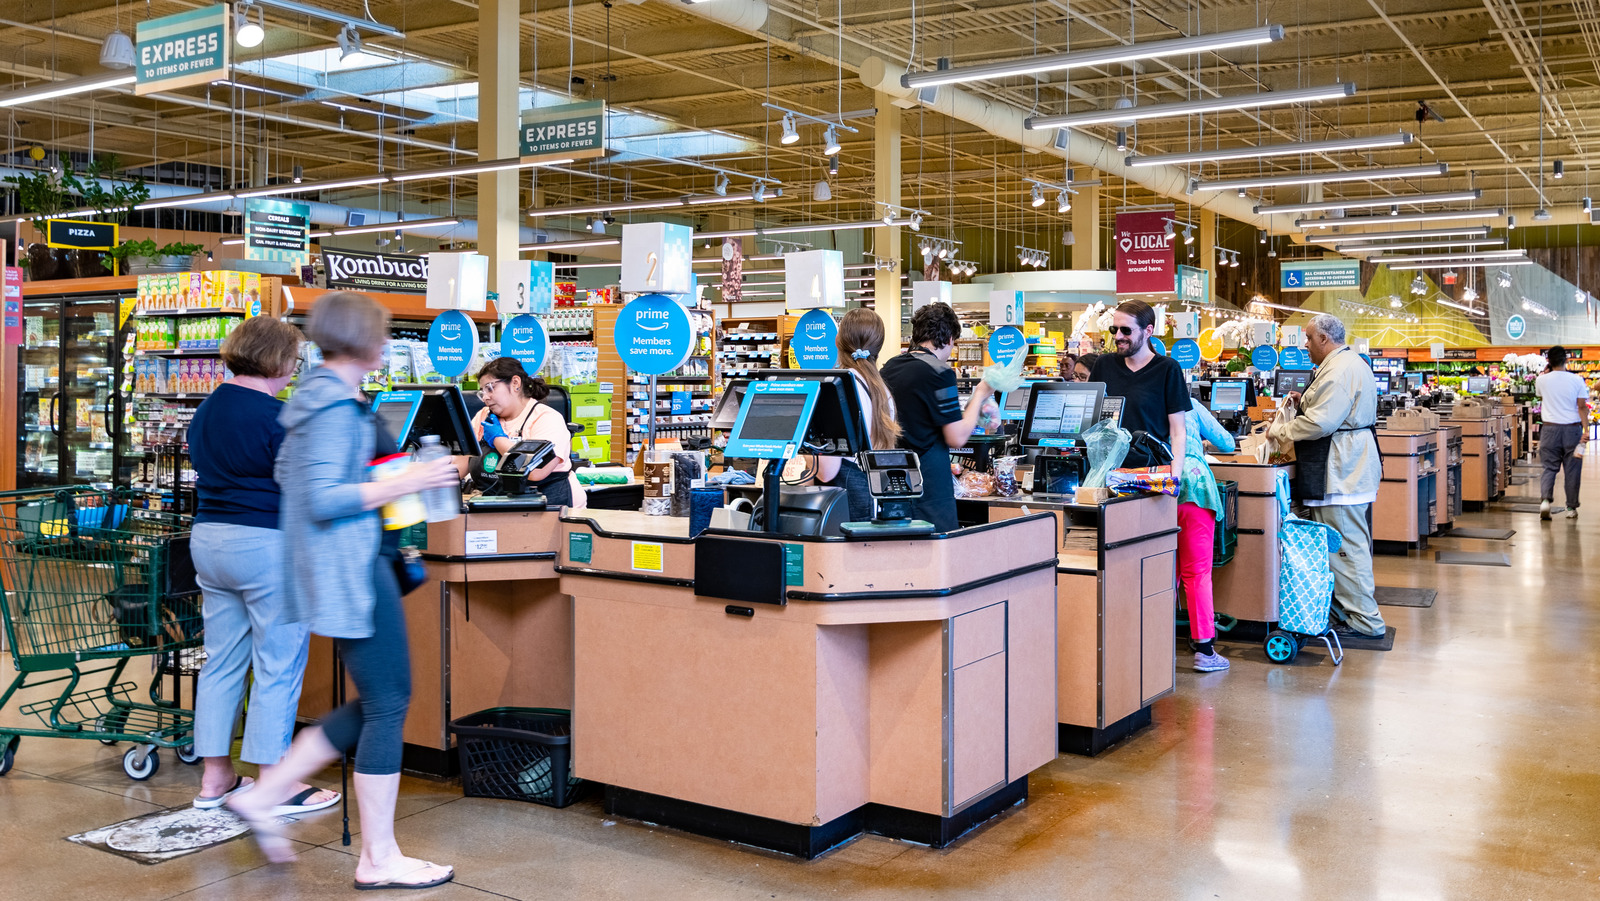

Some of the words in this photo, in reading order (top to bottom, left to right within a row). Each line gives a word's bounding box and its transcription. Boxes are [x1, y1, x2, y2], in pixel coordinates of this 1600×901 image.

[142, 32, 218, 65] EXPRESS
[146, 70, 154, 78] 10
[156, 64, 177, 76] ITEMS
[178, 62, 188, 71] OR
[190, 57, 214, 69] FEWER
[526, 121, 596, 142] EXPRESS
[572, 139, 592, 147] FEWER
[69, 228, 95, 237] PIZZA
[1134, 234, 1169, 249] LOCAL
[646, 252, 657, 286] 2
[448, 278, 455, 305] 1
[811, 274, 821, 303] 4
[517, 282, 524, 309] 3
[636, 308, 669, 321] prime
[1006, 305, 1012, 322] 6
[441, 322, 461, 332] prime
[513, 326, 533, 336] prime
[806, 321, 826, 332] prime
[1187, 323, 1192, 336] 8
[633, 337, 671, 346] Members
[1266, 332, 1270, 343] 9
[1288, 334, 1296, 344] 10
